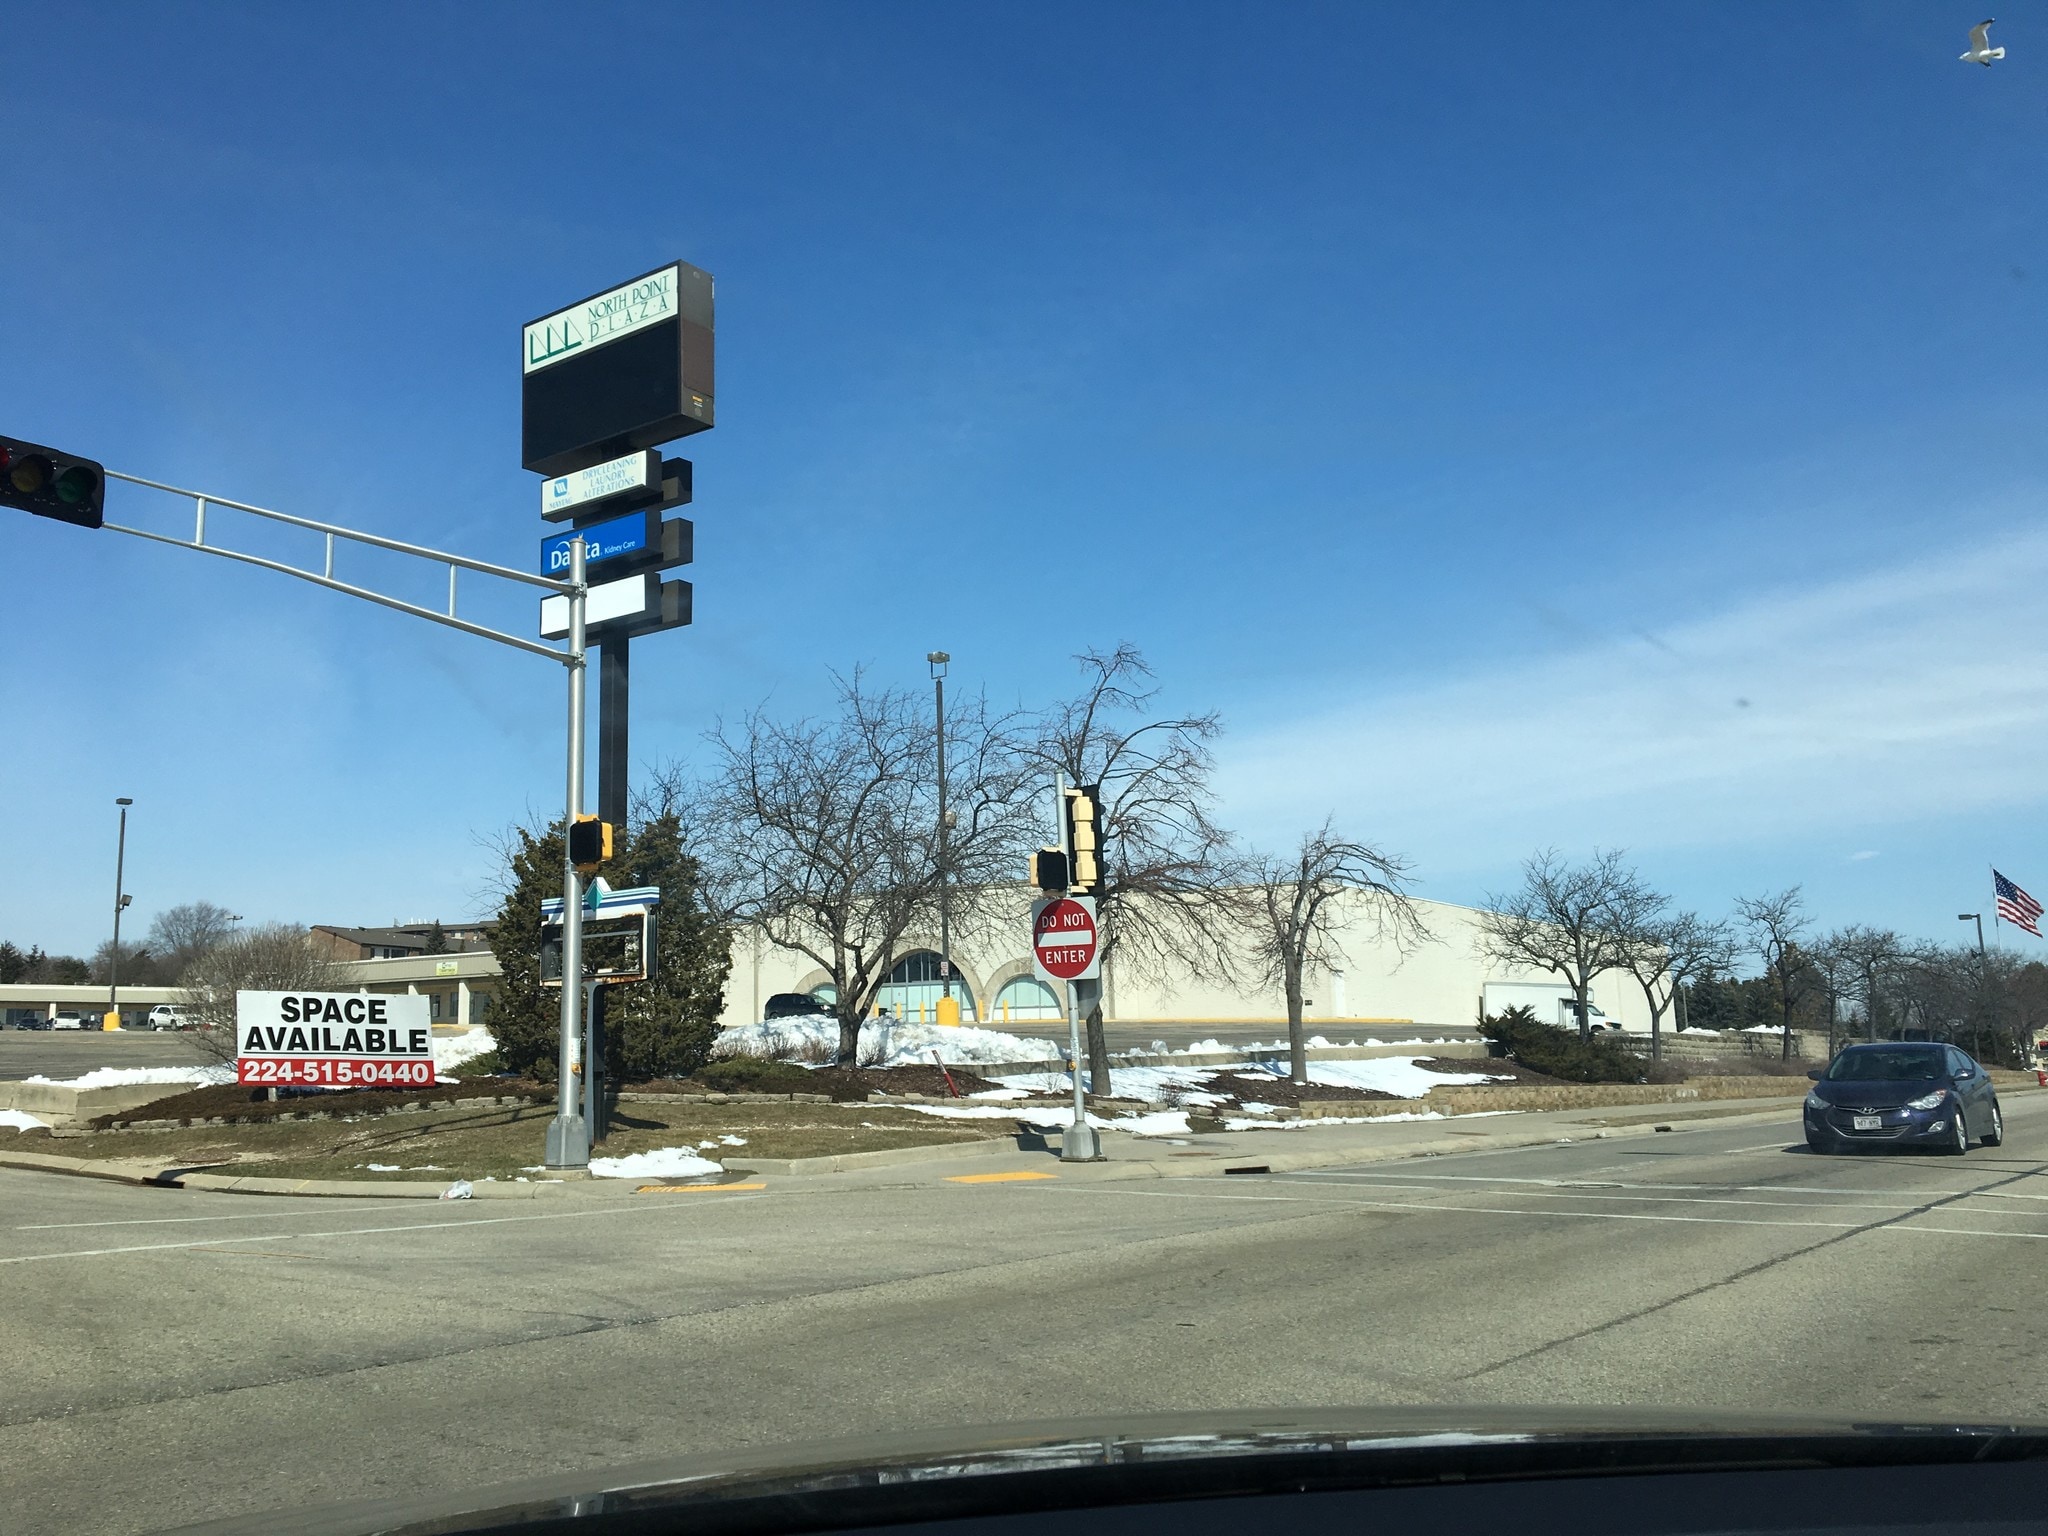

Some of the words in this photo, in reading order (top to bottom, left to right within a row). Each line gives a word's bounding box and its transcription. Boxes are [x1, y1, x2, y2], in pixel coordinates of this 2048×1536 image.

[588, 293, 627, 322] NORTH
[633, 275, 669, 303] POINT
[582, 456, 637, 480] DRYCLEANING
[591, 469, 626, 487] LAUNDRY
[584, 475, 635, 499] ALTERATIONS
[551, 541, 600, 570] Data
[604, 545, 622, 554] Kidney
[622, 540, 636, 550] Care
[1042, 915, 1057, 928] DO
[1063, 913, 1085, 927] NOT
[1046, 949, 1086, 964] ENTER
[281, 996, 387, 1024] SPACE
[244, 1026, 428, 1052] AVAILABLE
[244, 1061, 428, 1083] 224-515-0440
